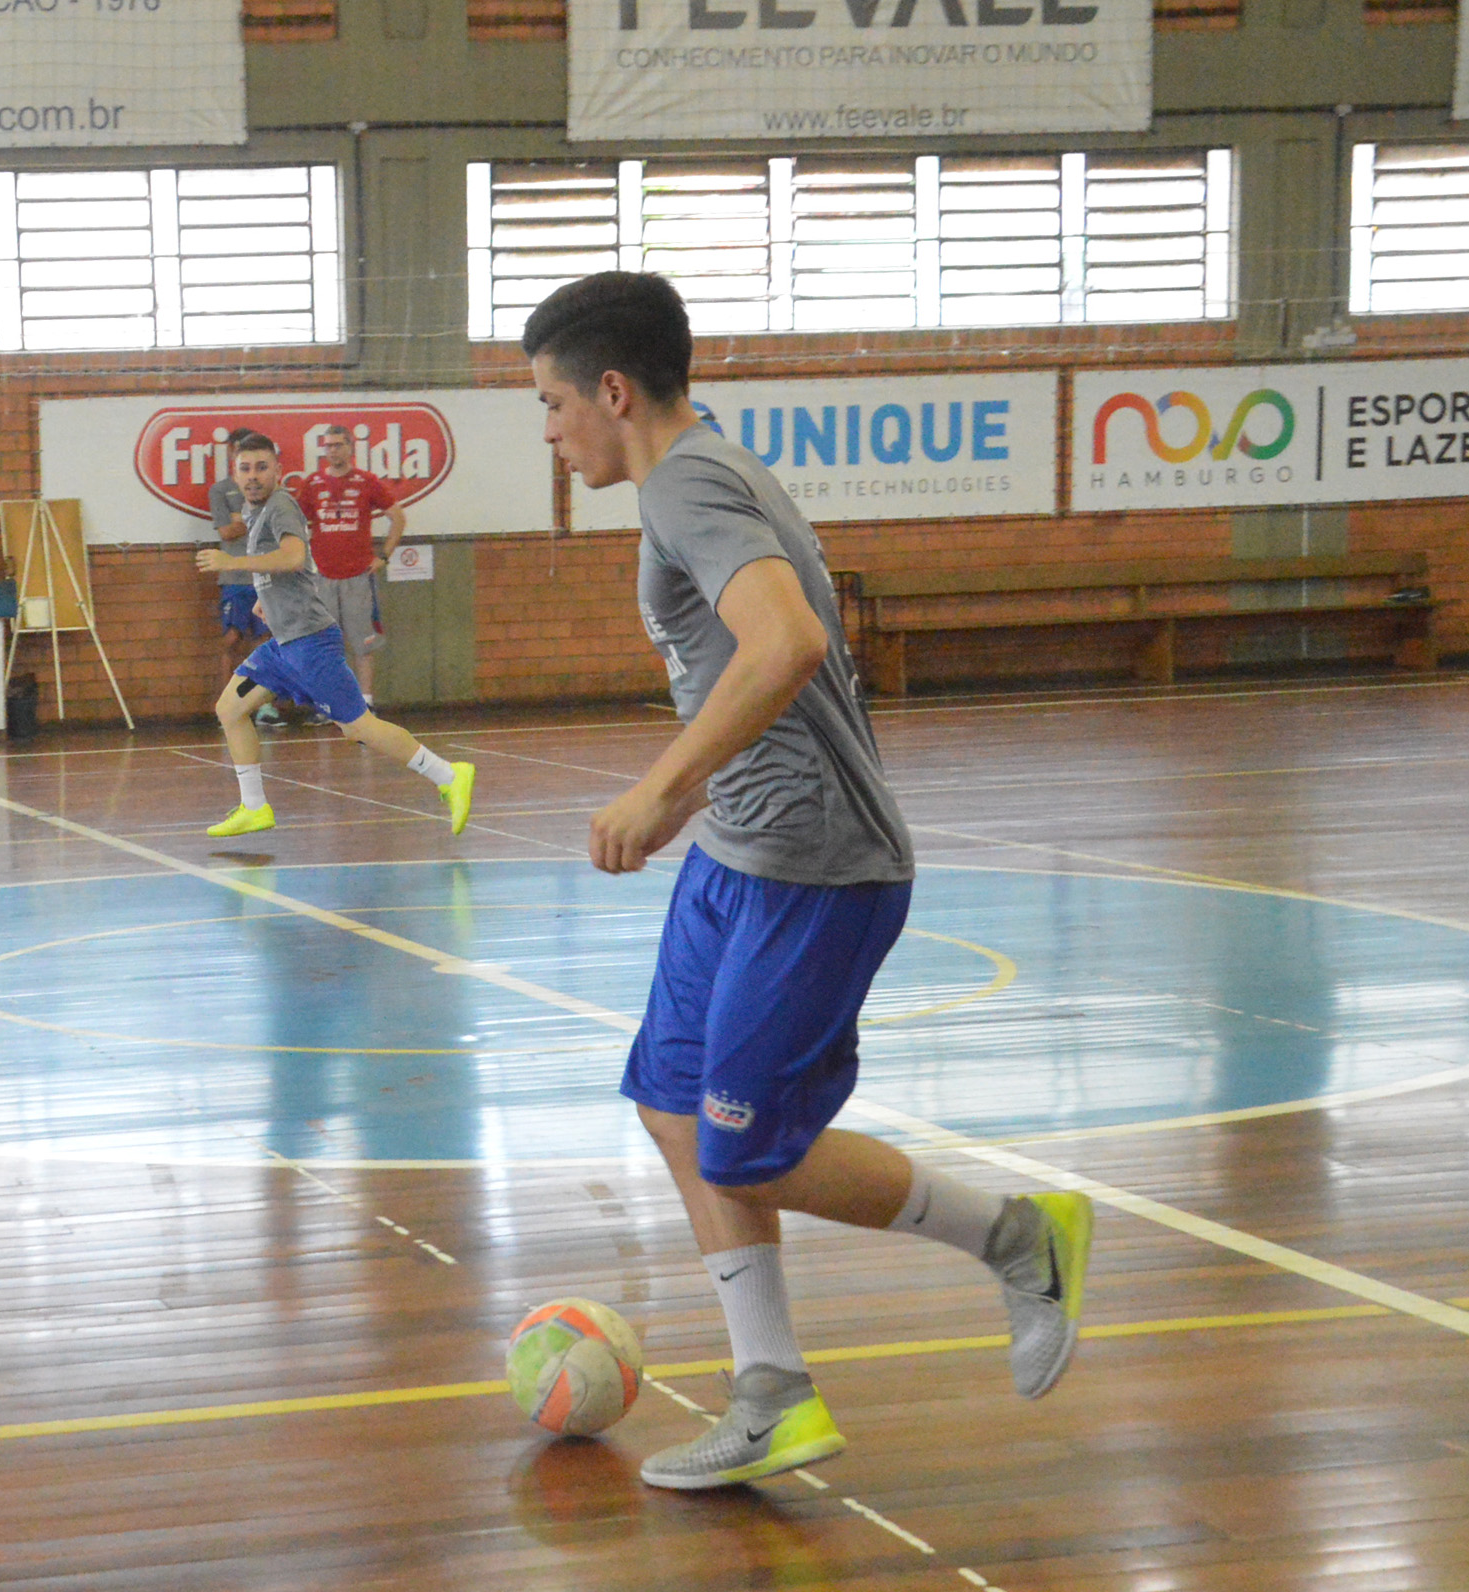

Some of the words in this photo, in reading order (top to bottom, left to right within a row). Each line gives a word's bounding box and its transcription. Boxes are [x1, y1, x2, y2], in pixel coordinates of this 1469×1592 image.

[617, 48, 814, 68] CONHECIMENTO
[820, 47, 882, 66] PARA
[889, 44, 976, 65] INOVAR
[983, 44, 1002, 63] O
[1009, 42, 1099, 63] MUNDO
[763, 103, 969, 130] www.feevale.br
[1348, 391, 1469, 427] ESPOR
[740, 400, 1010, 467] UNIQUE
[162, 427, 280, 485] Fri
[303, 422, 431, 480] Fida
[1348, 437, 1367, 468] E
[788, 482, 830, 499] BER
[843, 475, 1011, 497] TECHNOLOGIES
[1090, 466, 1294, 489] HAMBURGO
